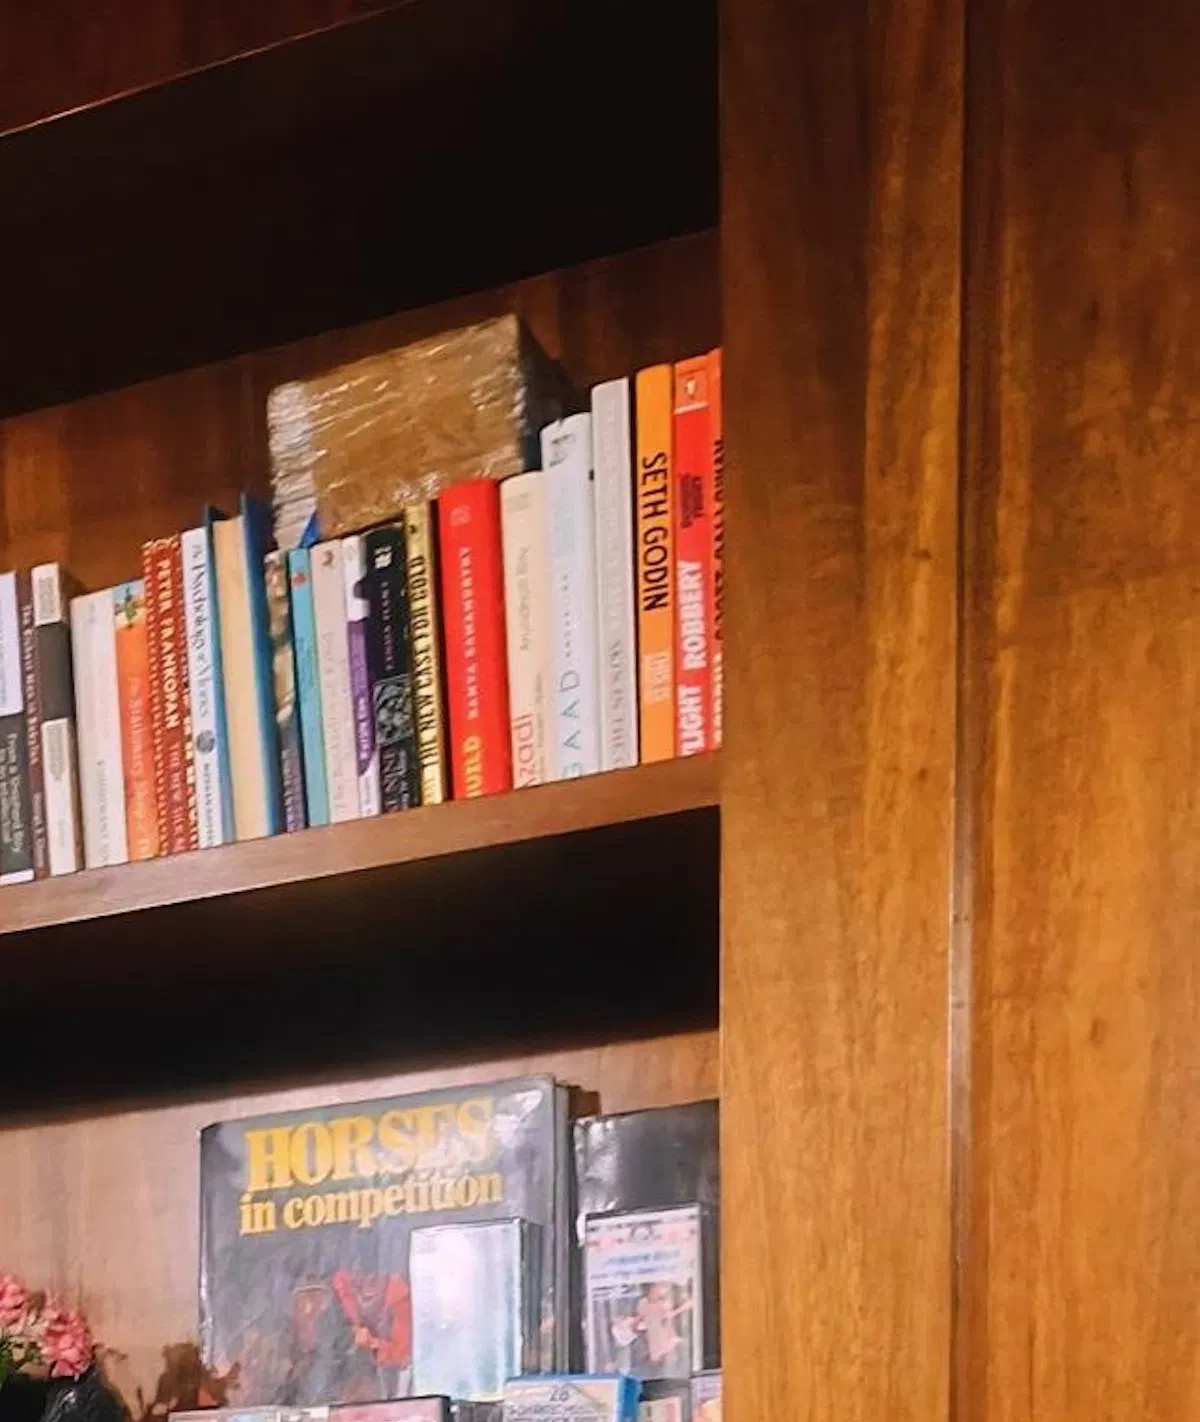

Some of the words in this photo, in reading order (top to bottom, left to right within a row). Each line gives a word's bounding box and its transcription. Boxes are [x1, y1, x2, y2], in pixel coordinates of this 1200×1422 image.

[641, 453, 668, 520] SETH
[157, 558, 173, 611] PETER
[409, 555, 428, 600] GOLD
[643, 526, 669, 612] GODIN
[22, 604, 33, 625] The
[190, 563, 208, 649] Psychology
[411, 606, 429, 640] FOR
[678, 560, 707, 669] ROBBERY
[160, 618, 179, 729] FRANKOPAN
[412, 643, 434, 691] CASE
[416, 695, 436, 730] NEW
[417, 737, 438, 769] THE
[245, 1098, 495, 1193] HORSES
[239, 1199, 276, 1235] in
[283, 1170, 503, 1229] competition
